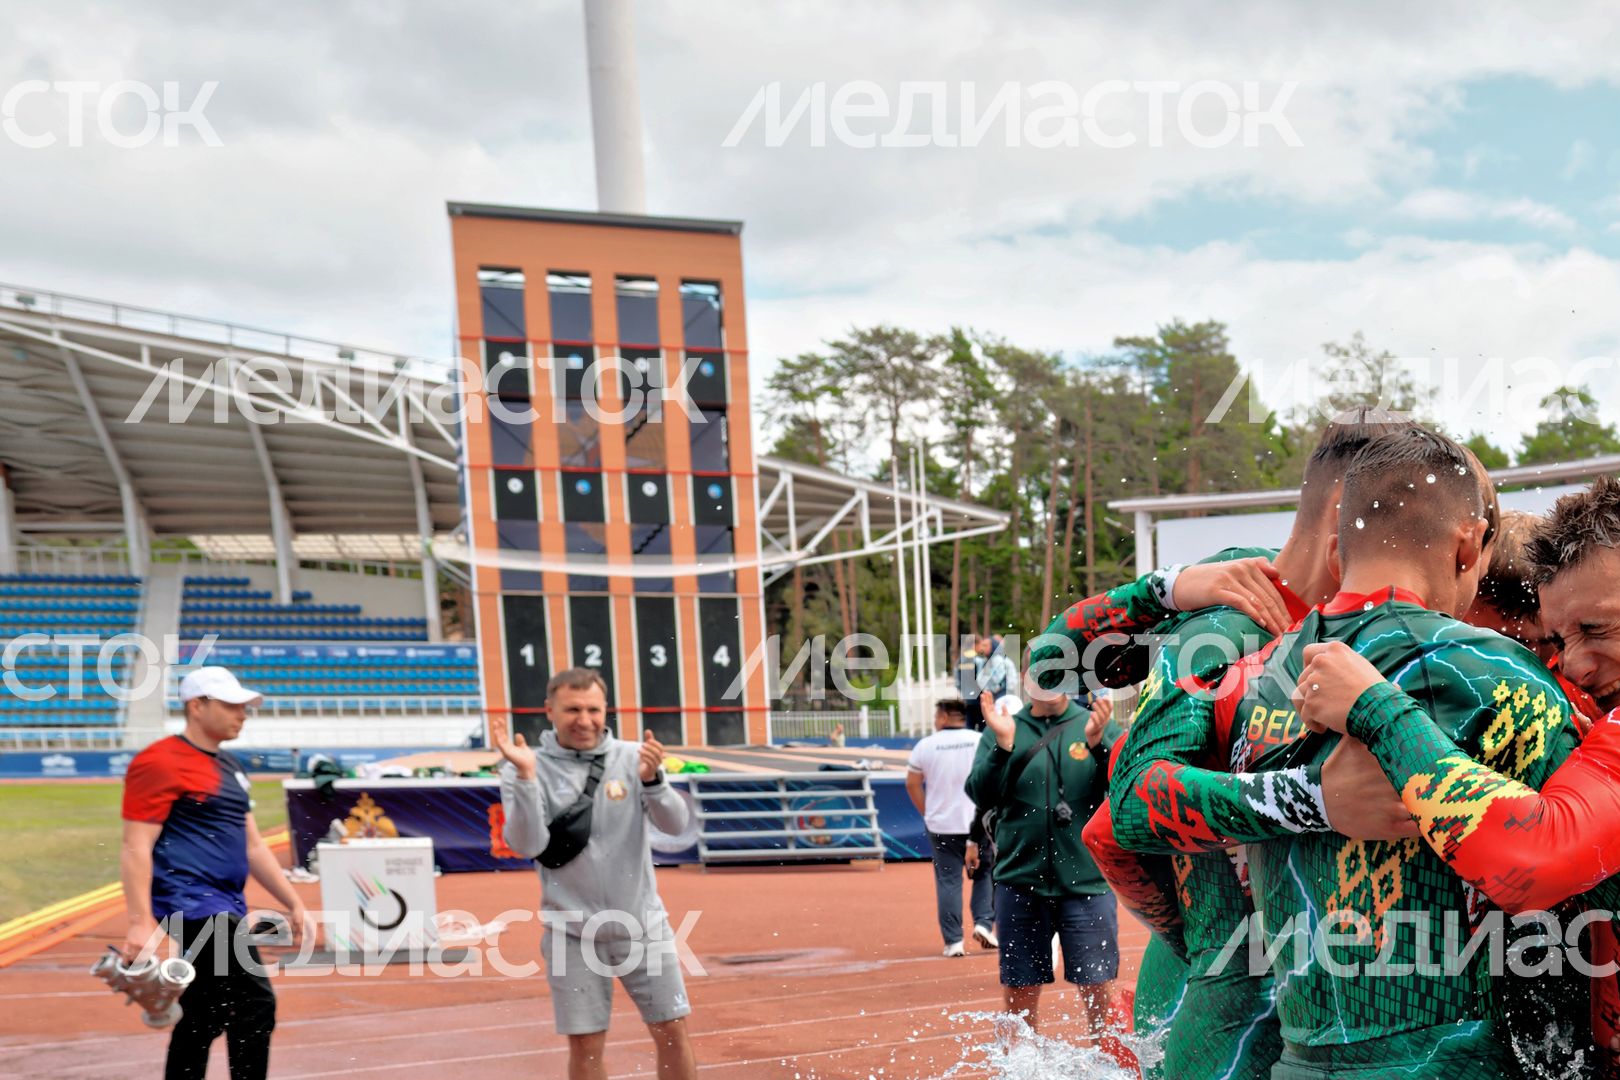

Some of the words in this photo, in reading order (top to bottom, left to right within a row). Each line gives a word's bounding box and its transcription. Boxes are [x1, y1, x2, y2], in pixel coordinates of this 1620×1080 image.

[520, 643, 534, 666] 1
[584, 644, 603, 667] 2
[650, 644, 668, 667] 3
[712, 645, 731, 667] 4
